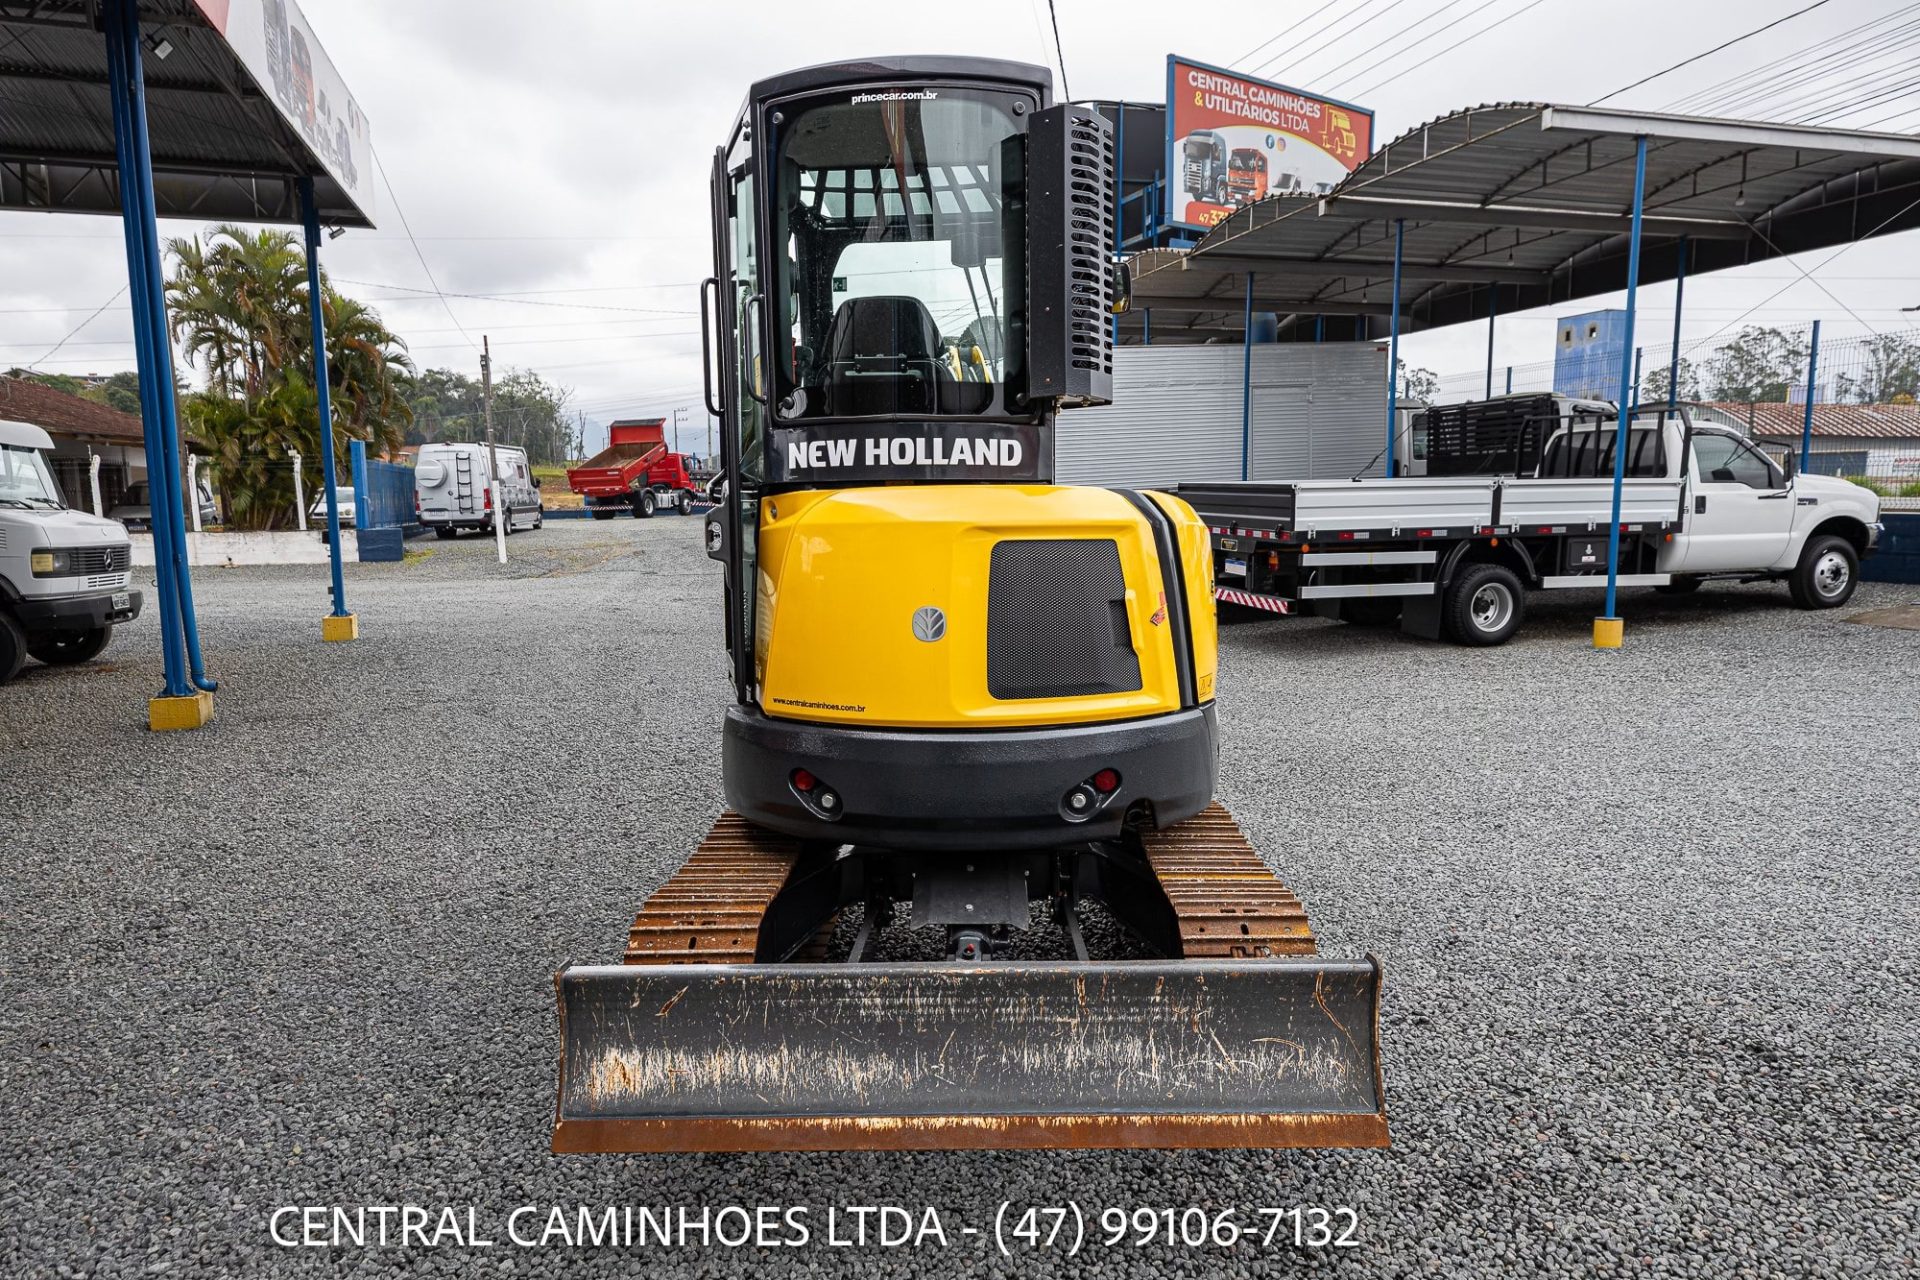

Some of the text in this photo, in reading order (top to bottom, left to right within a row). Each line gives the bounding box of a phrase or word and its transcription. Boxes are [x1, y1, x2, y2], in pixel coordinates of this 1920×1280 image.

[851, 90, 938, 106] princecar.com.br
[1188, 71, 1321, 118] CENTRAL CAMINHÕES
[1194, 91, 1310, 133] & UTILITÁRIOS LTDA
[788, 437, 1023, 470] NEW HOLLAND
